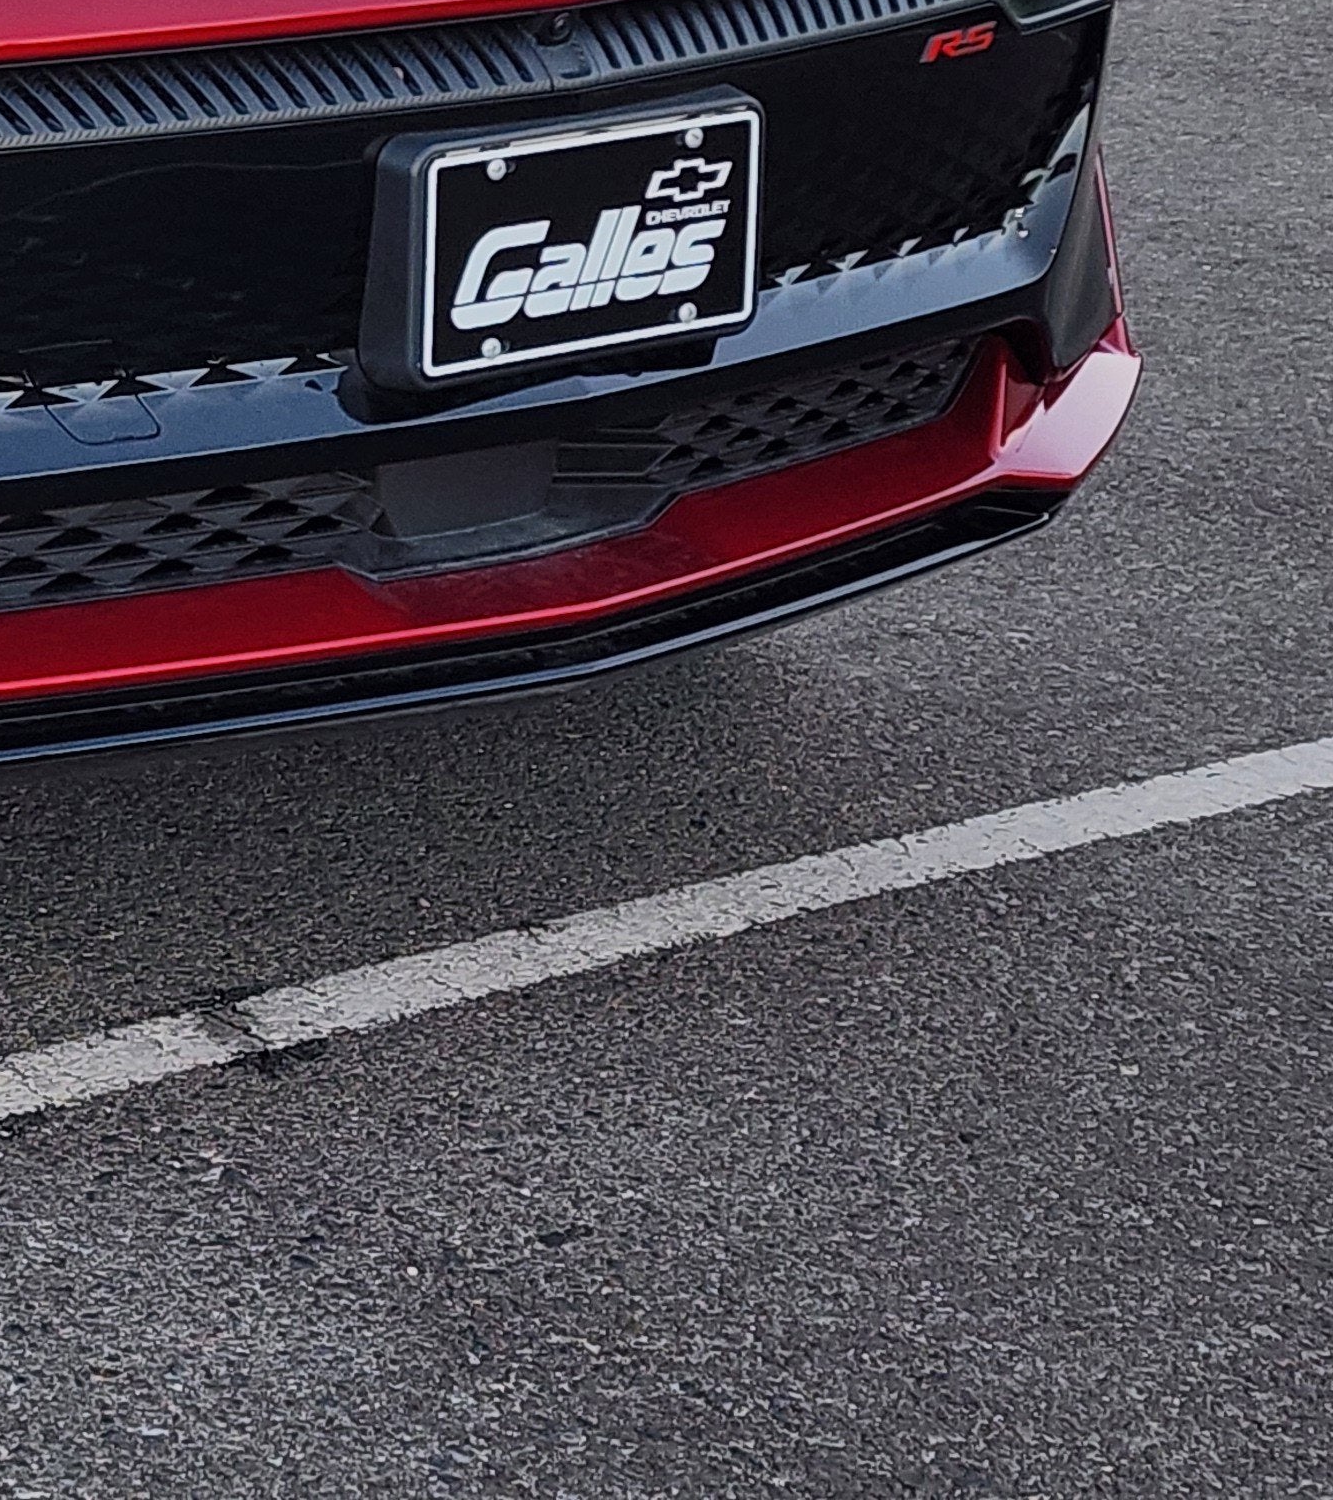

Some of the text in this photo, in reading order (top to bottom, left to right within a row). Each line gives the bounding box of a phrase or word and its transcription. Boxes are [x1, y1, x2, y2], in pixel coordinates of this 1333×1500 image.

[919, 20, 998, 64] RS
[645, 200, 731, 225] CHEVROLET
[450, 204, 727, 330] Galles
